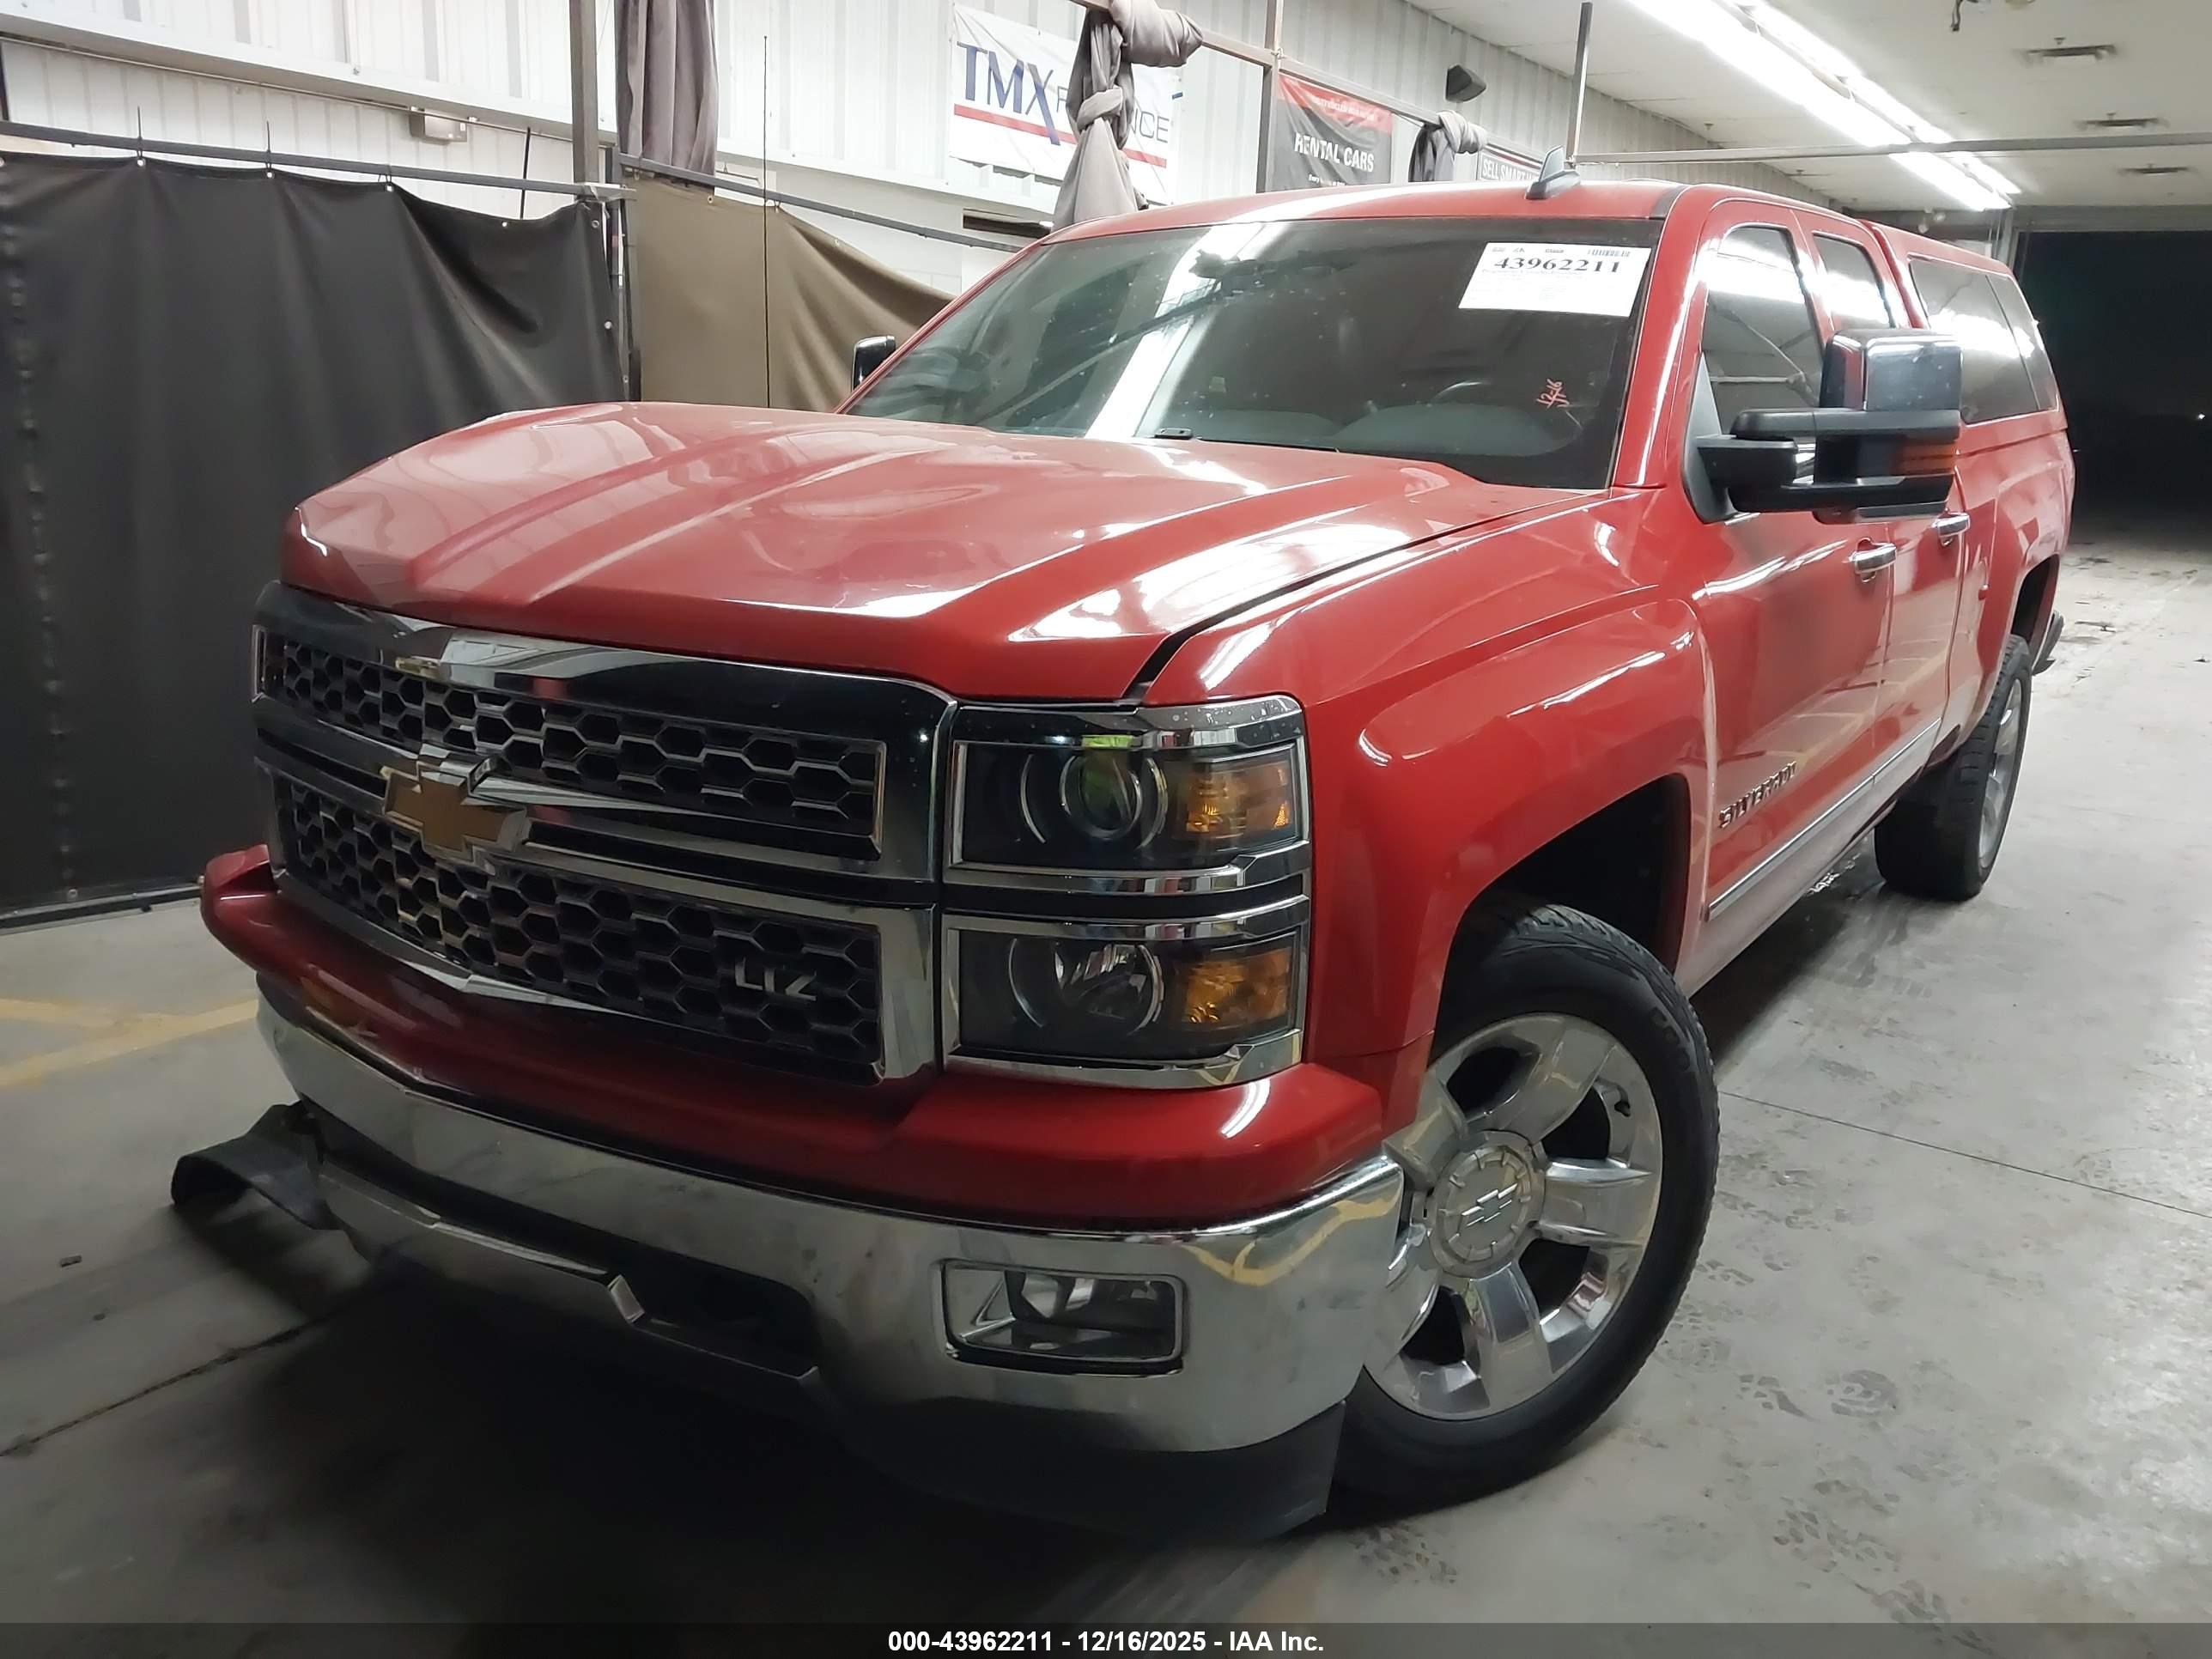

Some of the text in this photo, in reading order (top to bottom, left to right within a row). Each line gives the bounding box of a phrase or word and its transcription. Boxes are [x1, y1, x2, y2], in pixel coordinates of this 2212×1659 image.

[957, 41, 1060, 146] TMX
[1294, 133, 1375, 173] RENTAL CARS
[1482, 158, 1498, 180] SELL
[1493, 257, 1620, 273] 43962211
